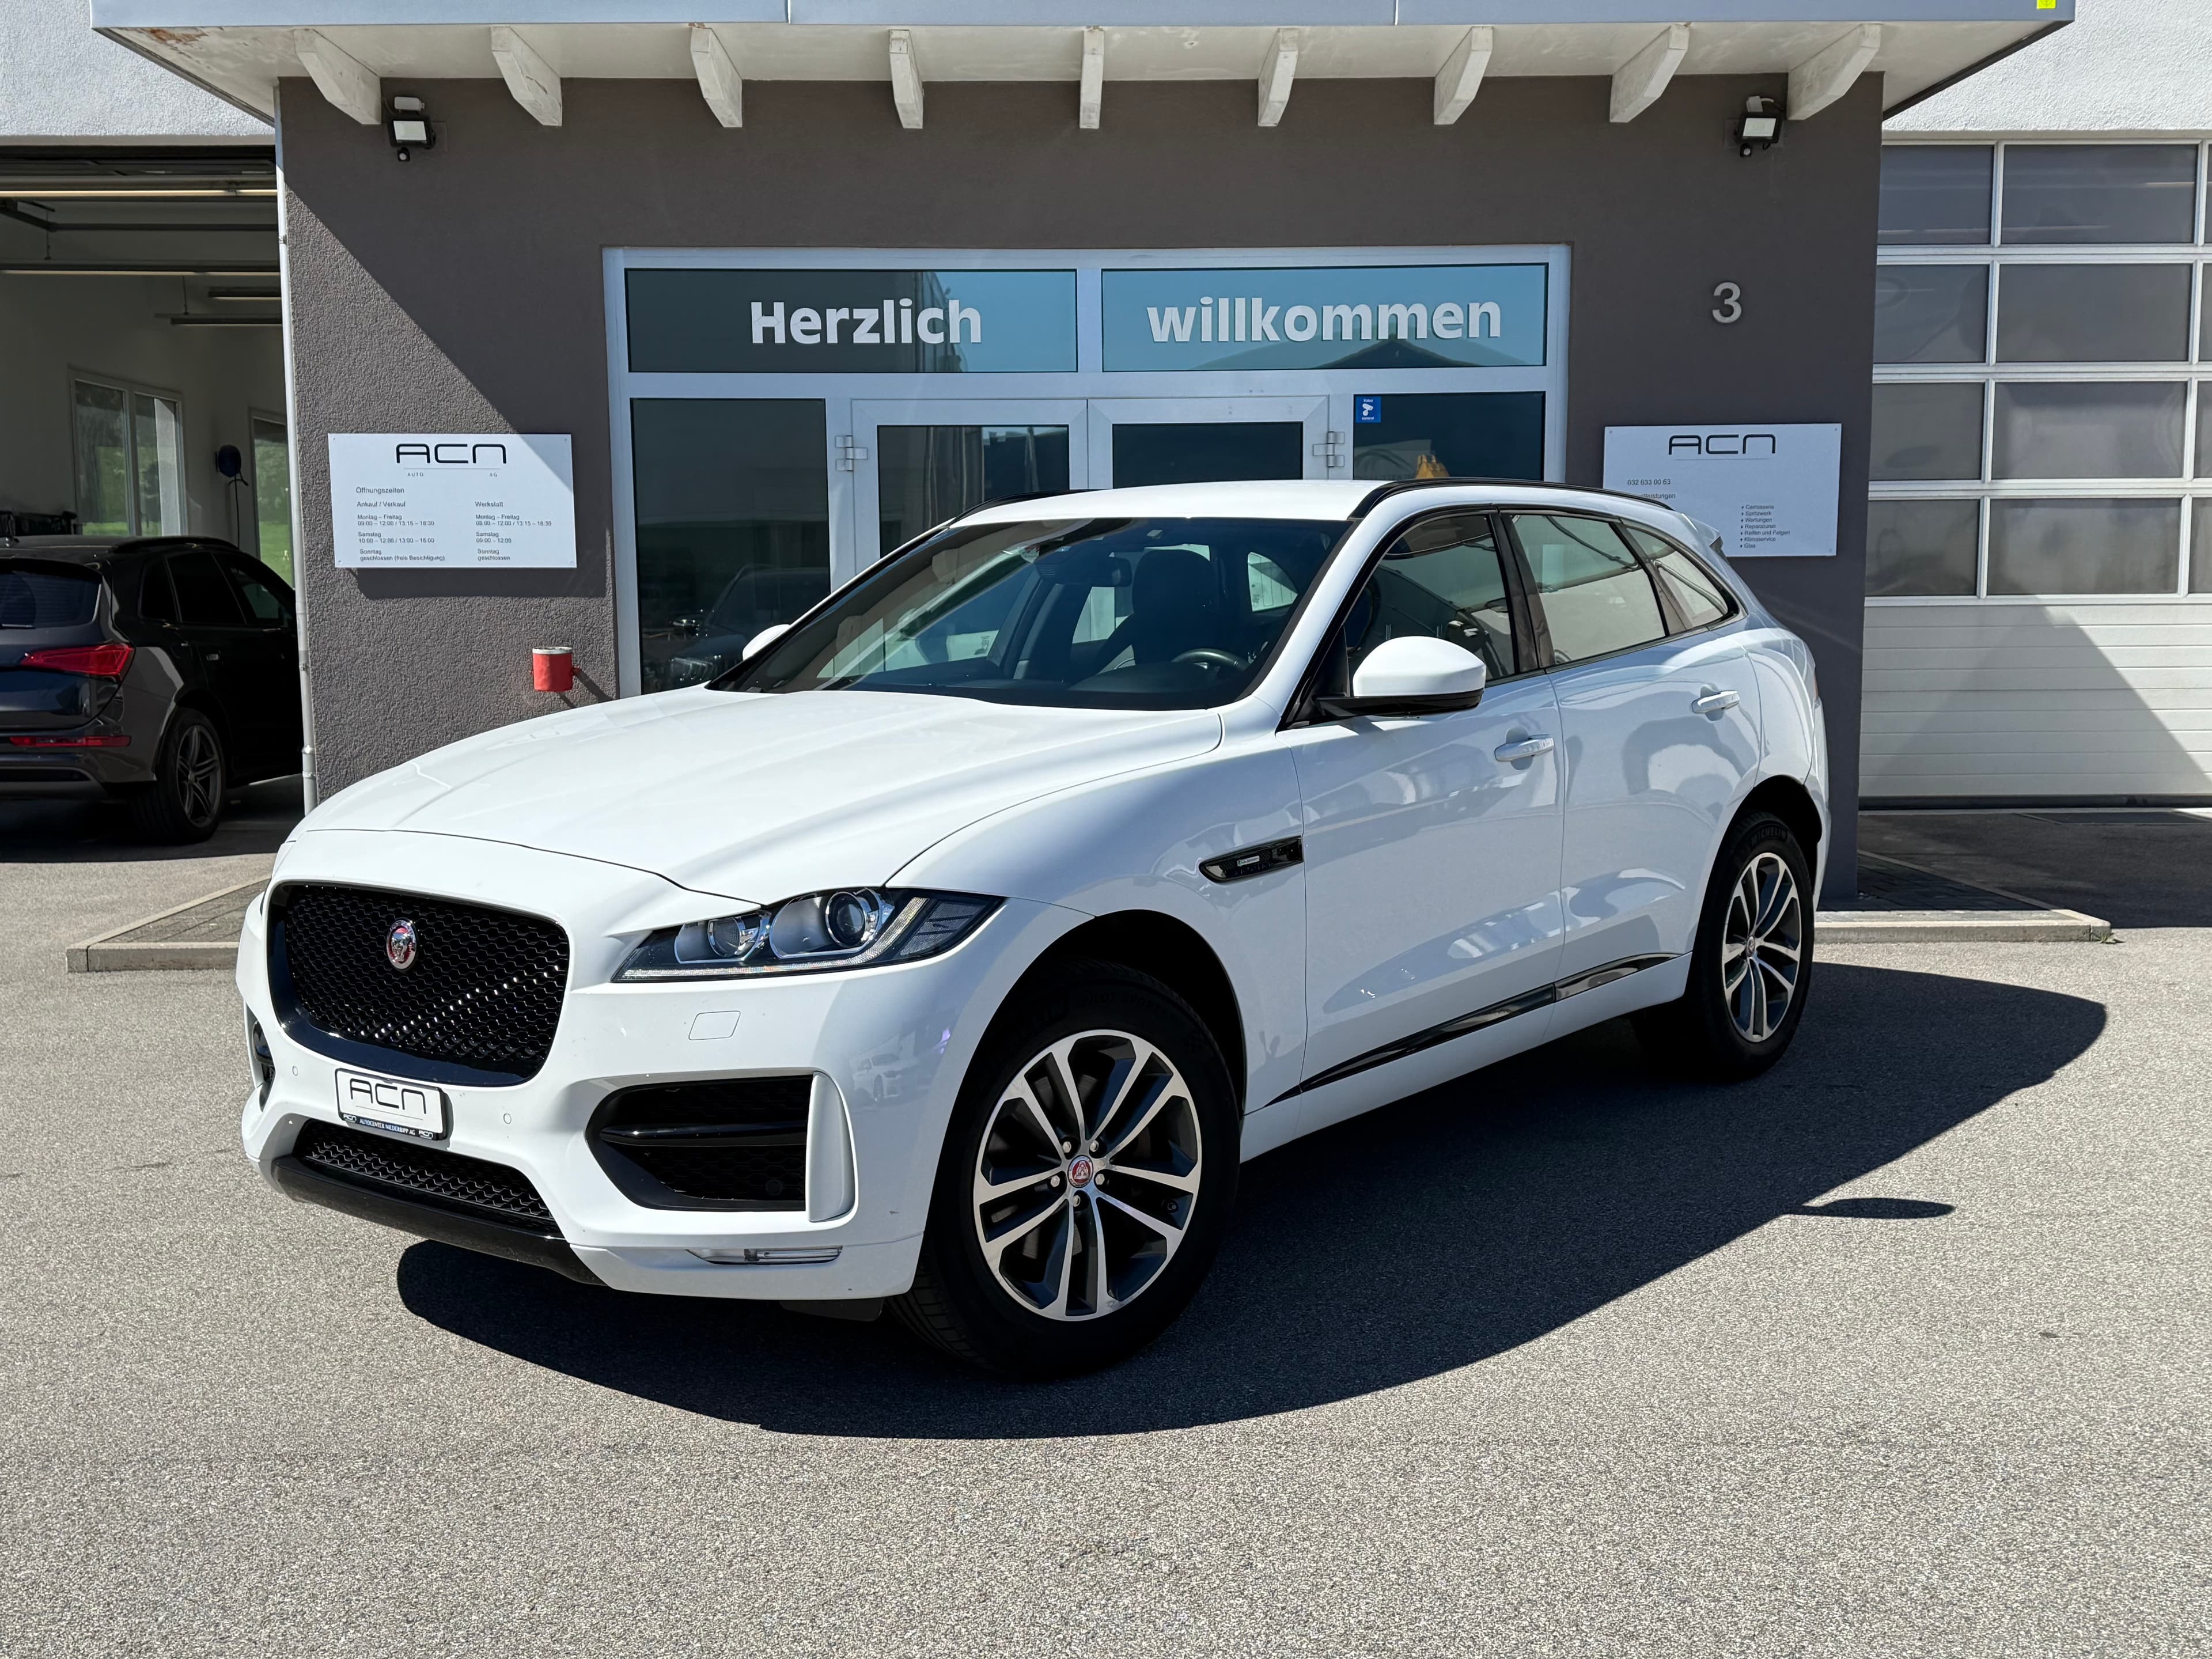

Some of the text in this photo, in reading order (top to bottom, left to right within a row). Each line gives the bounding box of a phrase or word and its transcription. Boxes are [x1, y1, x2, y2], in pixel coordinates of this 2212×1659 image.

[751, 296, 1501, 344] Herzlich willkommen
[1712, 281, 1742, 323] 3
[359, 1118, 385, 1129] AUTOCENTER
